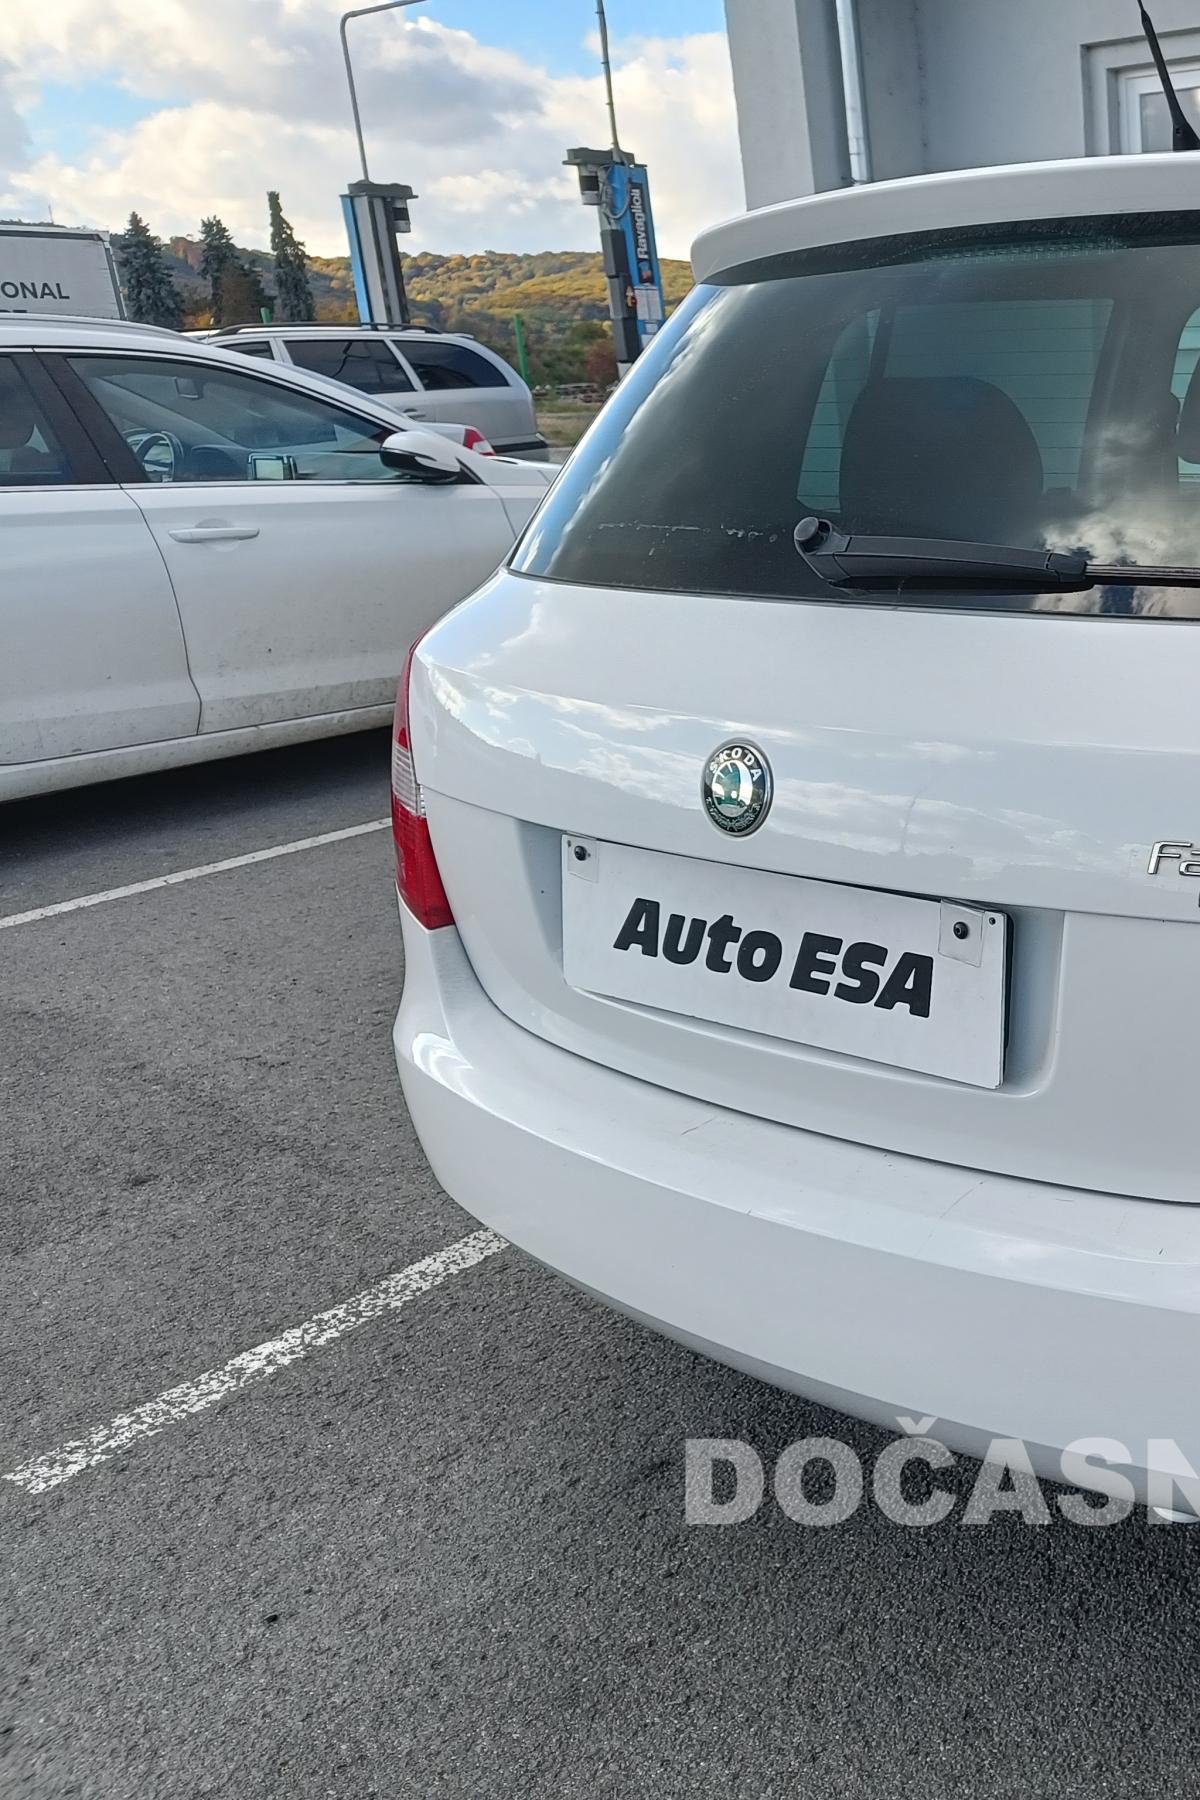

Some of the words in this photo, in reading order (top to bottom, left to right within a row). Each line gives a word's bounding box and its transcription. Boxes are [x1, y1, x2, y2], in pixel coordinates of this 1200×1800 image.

[631, 188, 649, 259] Ravaglioli
[613, 897, 783, 983] Auto
[789, 931, 934, 1019] ESA
